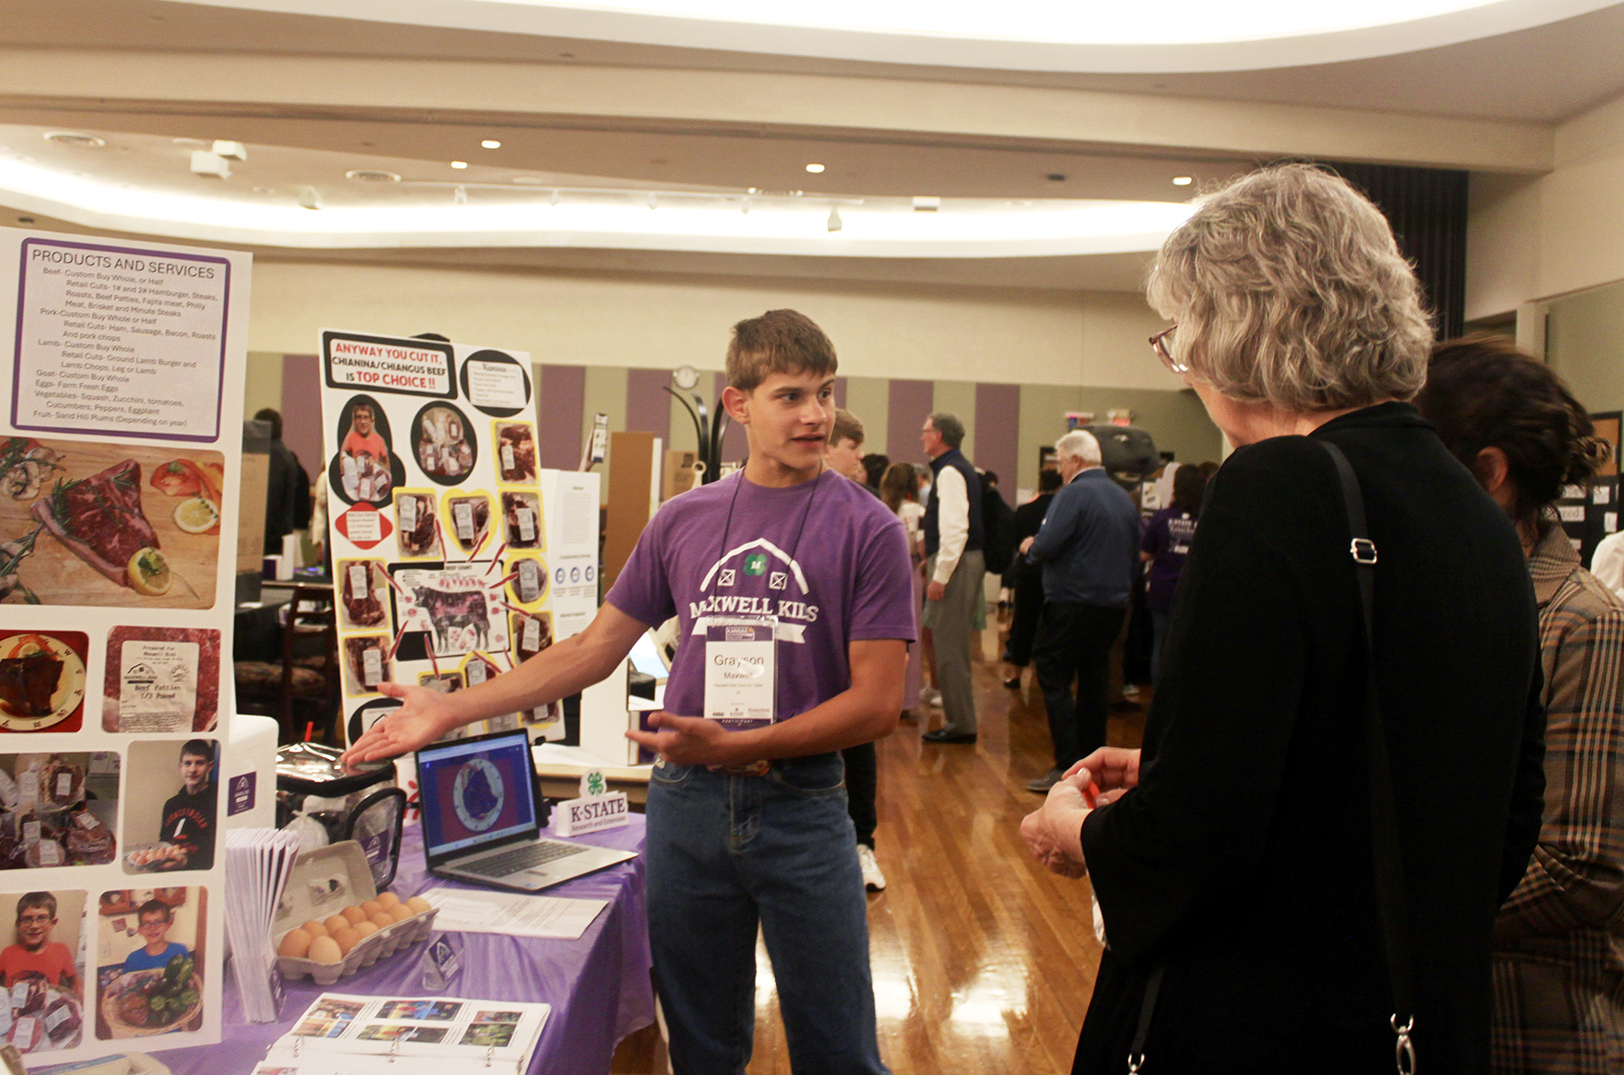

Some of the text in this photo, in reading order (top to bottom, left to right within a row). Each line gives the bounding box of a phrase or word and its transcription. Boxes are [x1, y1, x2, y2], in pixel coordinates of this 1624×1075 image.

[32, 249, 215, 279] PRODUCTS AND SERVICES
[43, 267, 63, 275] Beef-
[64, 269, 96, 278] Custom
[96, 272, 110, 281] Buy
[111, 274, 137, 284] Whole,
[66, 280, 88, 288] Retail
[148, 288, 190, 298] Hamburger,
[192, 292, 218, 301] Steaks,
[66, 290, 94, 299] Roasts,
[114, 294, 141, 304] Patties,
[142, 297, 162, 306] Fajita
[164, 300, 184, 308] meat,
[186, 301, 206, 311] Philly
[65, 300, 86, 308] Meat,
[88, 302, 114, 310] Brisket
[130, 306, 156, 314] Minute
[157, 308, 182, 317] Steaks
[92, 312, 106, 322] Buy
[107, 314, 130, 322] Whole
[64, 320, 86, 328] Retail
[108, 324, 129, 333] Ham,
[130, 326, 163, 336] Sausage,
[165, 329, 190, 338] Bacon,
[192, 331, 216, 340] Roasts
[79, 333, 96, 341] pork
[98, 334, 120, 342] chops
[38, 338, 135, 353] Lamb- Custom Buy Whole
[62, 350, 83, 358] Retail
[106, 354, 134, 363] Ground
[158, 358, 182, 368] Burger
[336, 342, 442, 365] ANYWAY YOU CUT IT,
[84, 362, 110, 371] Chops,
[112, 365, 126, 374] Leg
[427, 366, 446, 376] BEEF
[59, 370, 90, 379] Custom
[90, 373, 104, 382] Buy
[106, 374, 130, 383] Whole
[346, 372, 355, 381] IS
[356, 371, 380, 384] TOP
[382, 374, 427, 388] CHOICE
[78, 382, 100, 390] Fresh
[101, 384, 118, 393] Eggs
[81, 392, 111, 402] Squash,
[112, 395, 146, 404] Zucchini,
[46, 400, 160, 415] Cucumbers, Peppers, Eggplant
[56, 412, 75, 420] Sand
[90, 414, 114, 422] Plums
[115, 416, 158, 426] (Depending
[689, 596, 774, 619] MXWELL
[714, 654, 764, 668] Grayson
